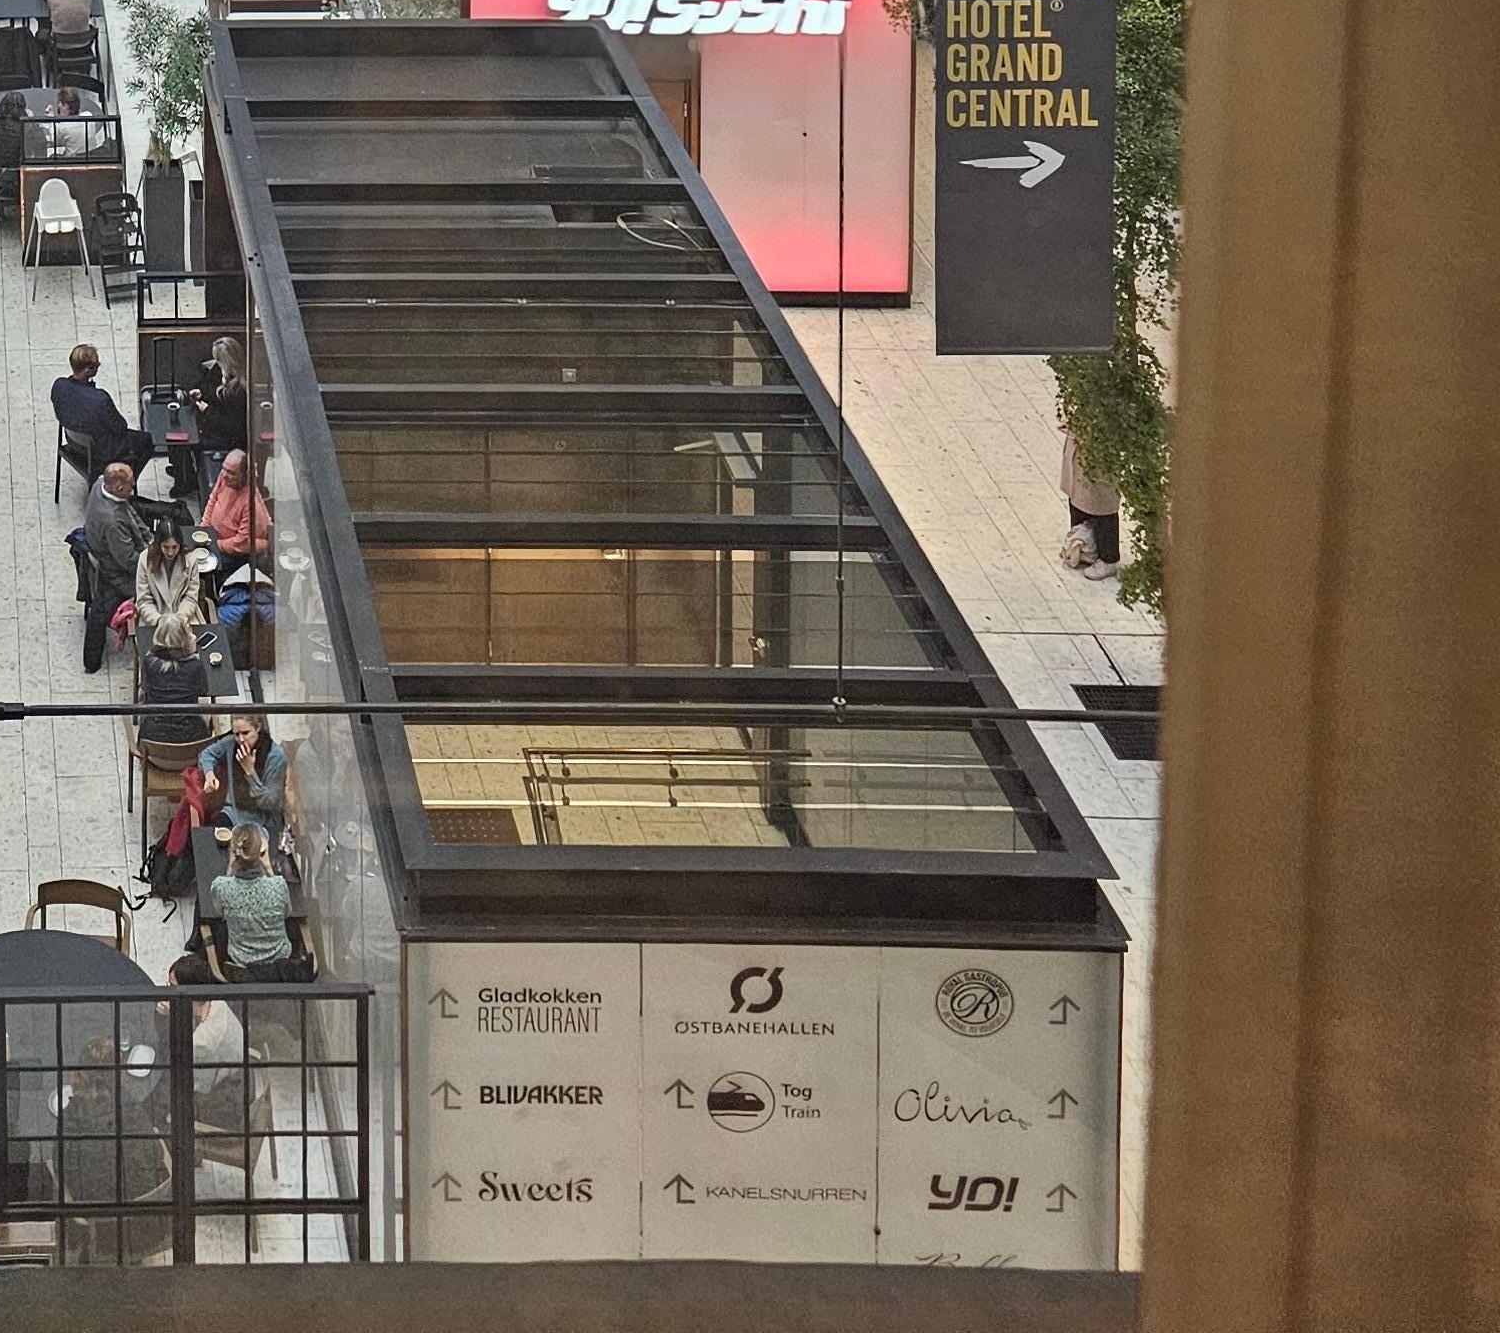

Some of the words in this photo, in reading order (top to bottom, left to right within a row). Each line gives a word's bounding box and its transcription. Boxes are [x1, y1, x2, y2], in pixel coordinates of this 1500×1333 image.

[946, 43, 1063, 82] GRAND
[946, 89, 1099, 127] CENTRAL
[478, 987, 602, 1004] Gladkokken
[478, 1006, 602, 1033] RESTAURANT
[480, 1085, 603, 1105] BLIVAKKER
[781, 1083, 813, 1101] Tog
[894, 1081, 1032, 1130] Olivia
[781, 1105, 821, 1119] Train
[478, 1170, 593, 1203] Sweets
[706, 1186, 868, 1201] KANELSNURREN
[928, 1174, 1020, 1213] YO!
